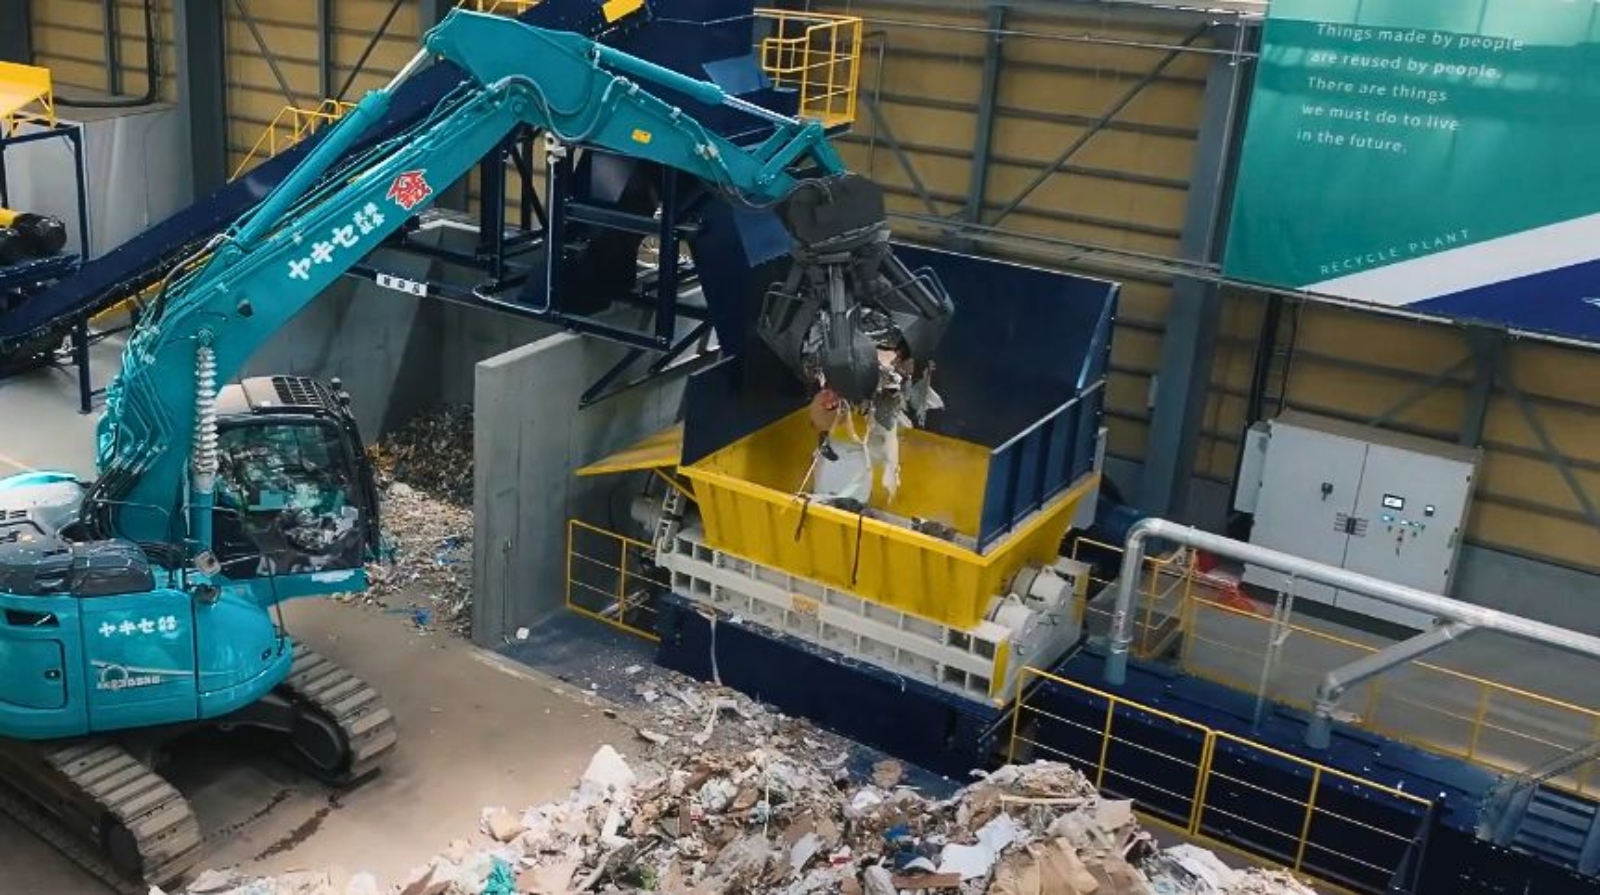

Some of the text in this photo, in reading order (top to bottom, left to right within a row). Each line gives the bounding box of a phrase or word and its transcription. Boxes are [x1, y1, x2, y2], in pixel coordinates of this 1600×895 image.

[1317, 23, 1524, 52] Things made by people
[1310, 52, 1502, 79] are reused by people.
[1308, 76, 1448, 105] There are things
[1302, 104, 1459, 131] we must do to live
[1297, 129, 1408, 155] in the future.
[1320, 229, 1469, 275] RECYCLE PLANT
